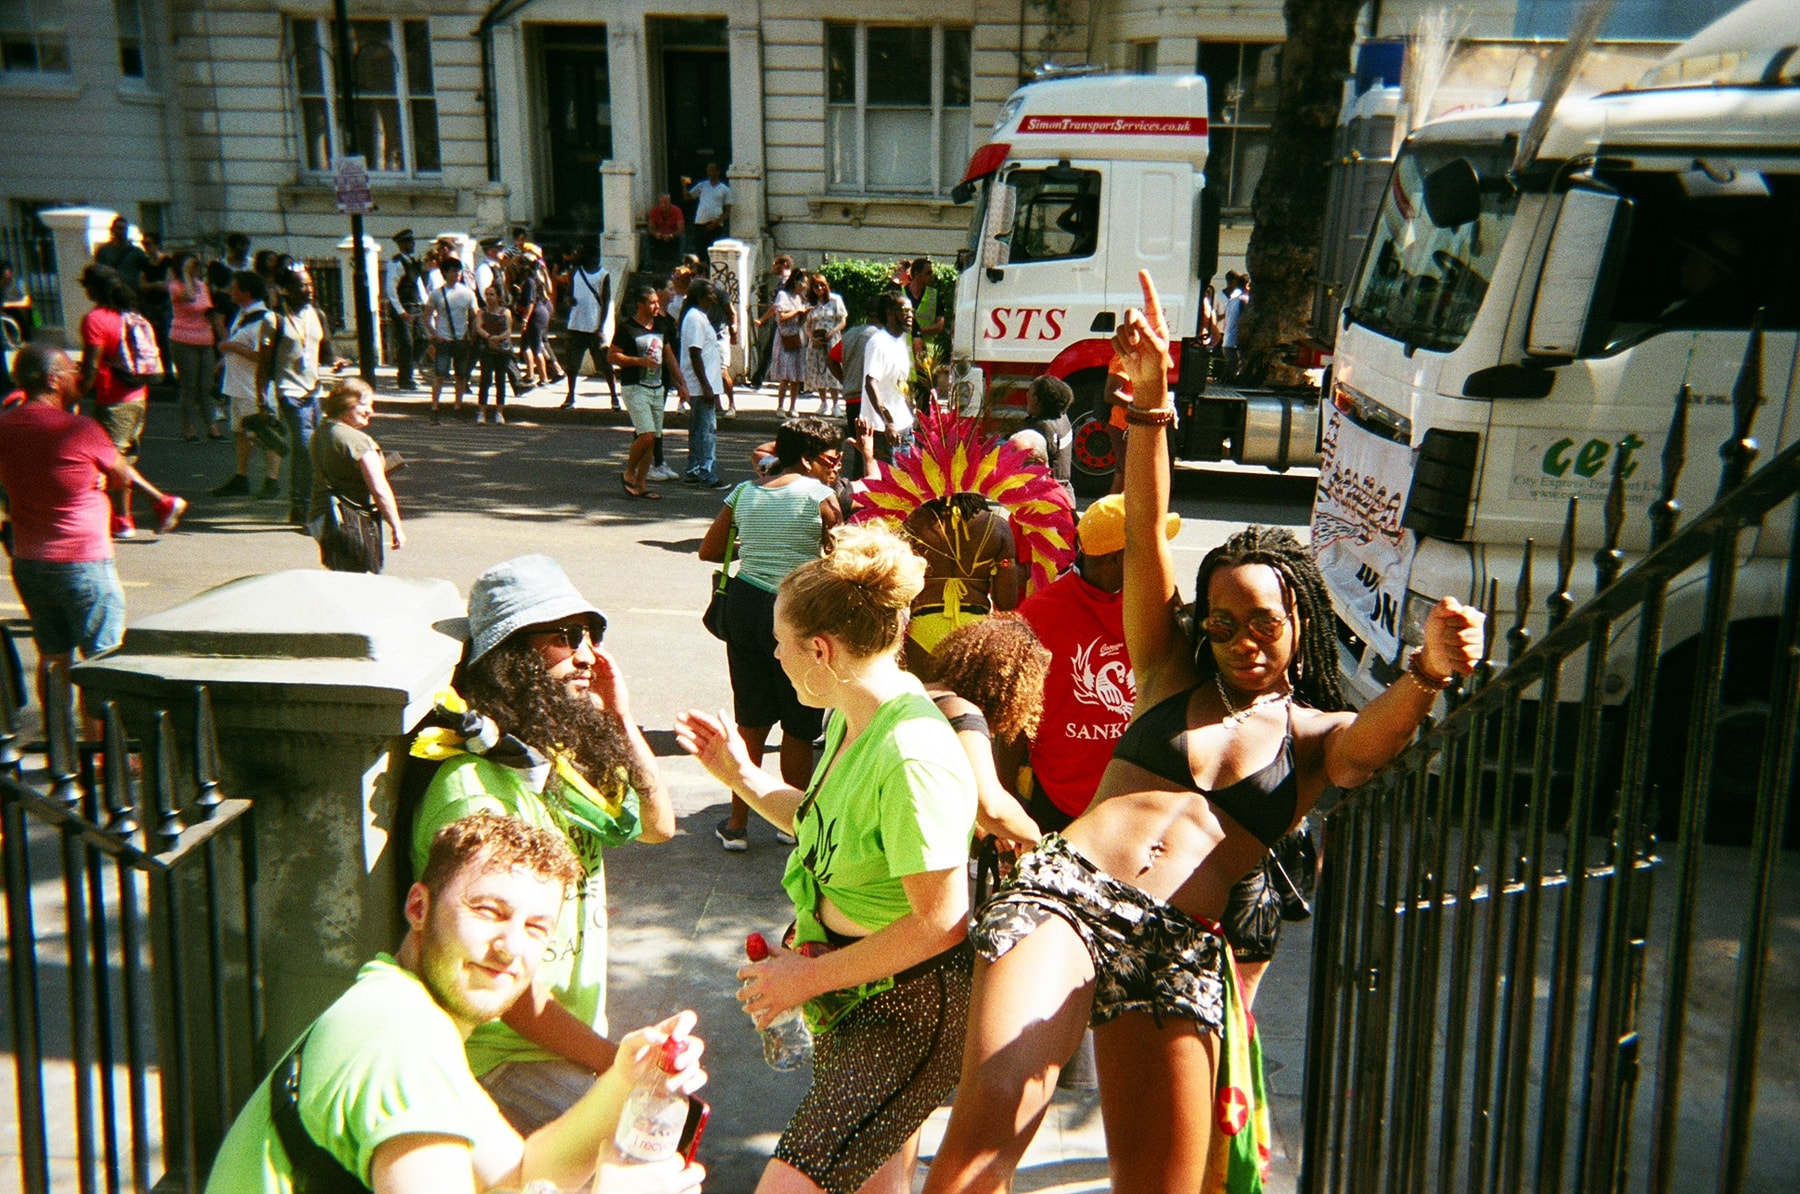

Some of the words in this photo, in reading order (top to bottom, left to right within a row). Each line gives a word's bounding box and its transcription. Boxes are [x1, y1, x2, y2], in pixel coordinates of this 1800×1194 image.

[1028, 118, 1191, 133] SimonTransportServices.co.uk
[983, 307, 1067, 340] STS
[1065, 722, 1130, 740] SANK
